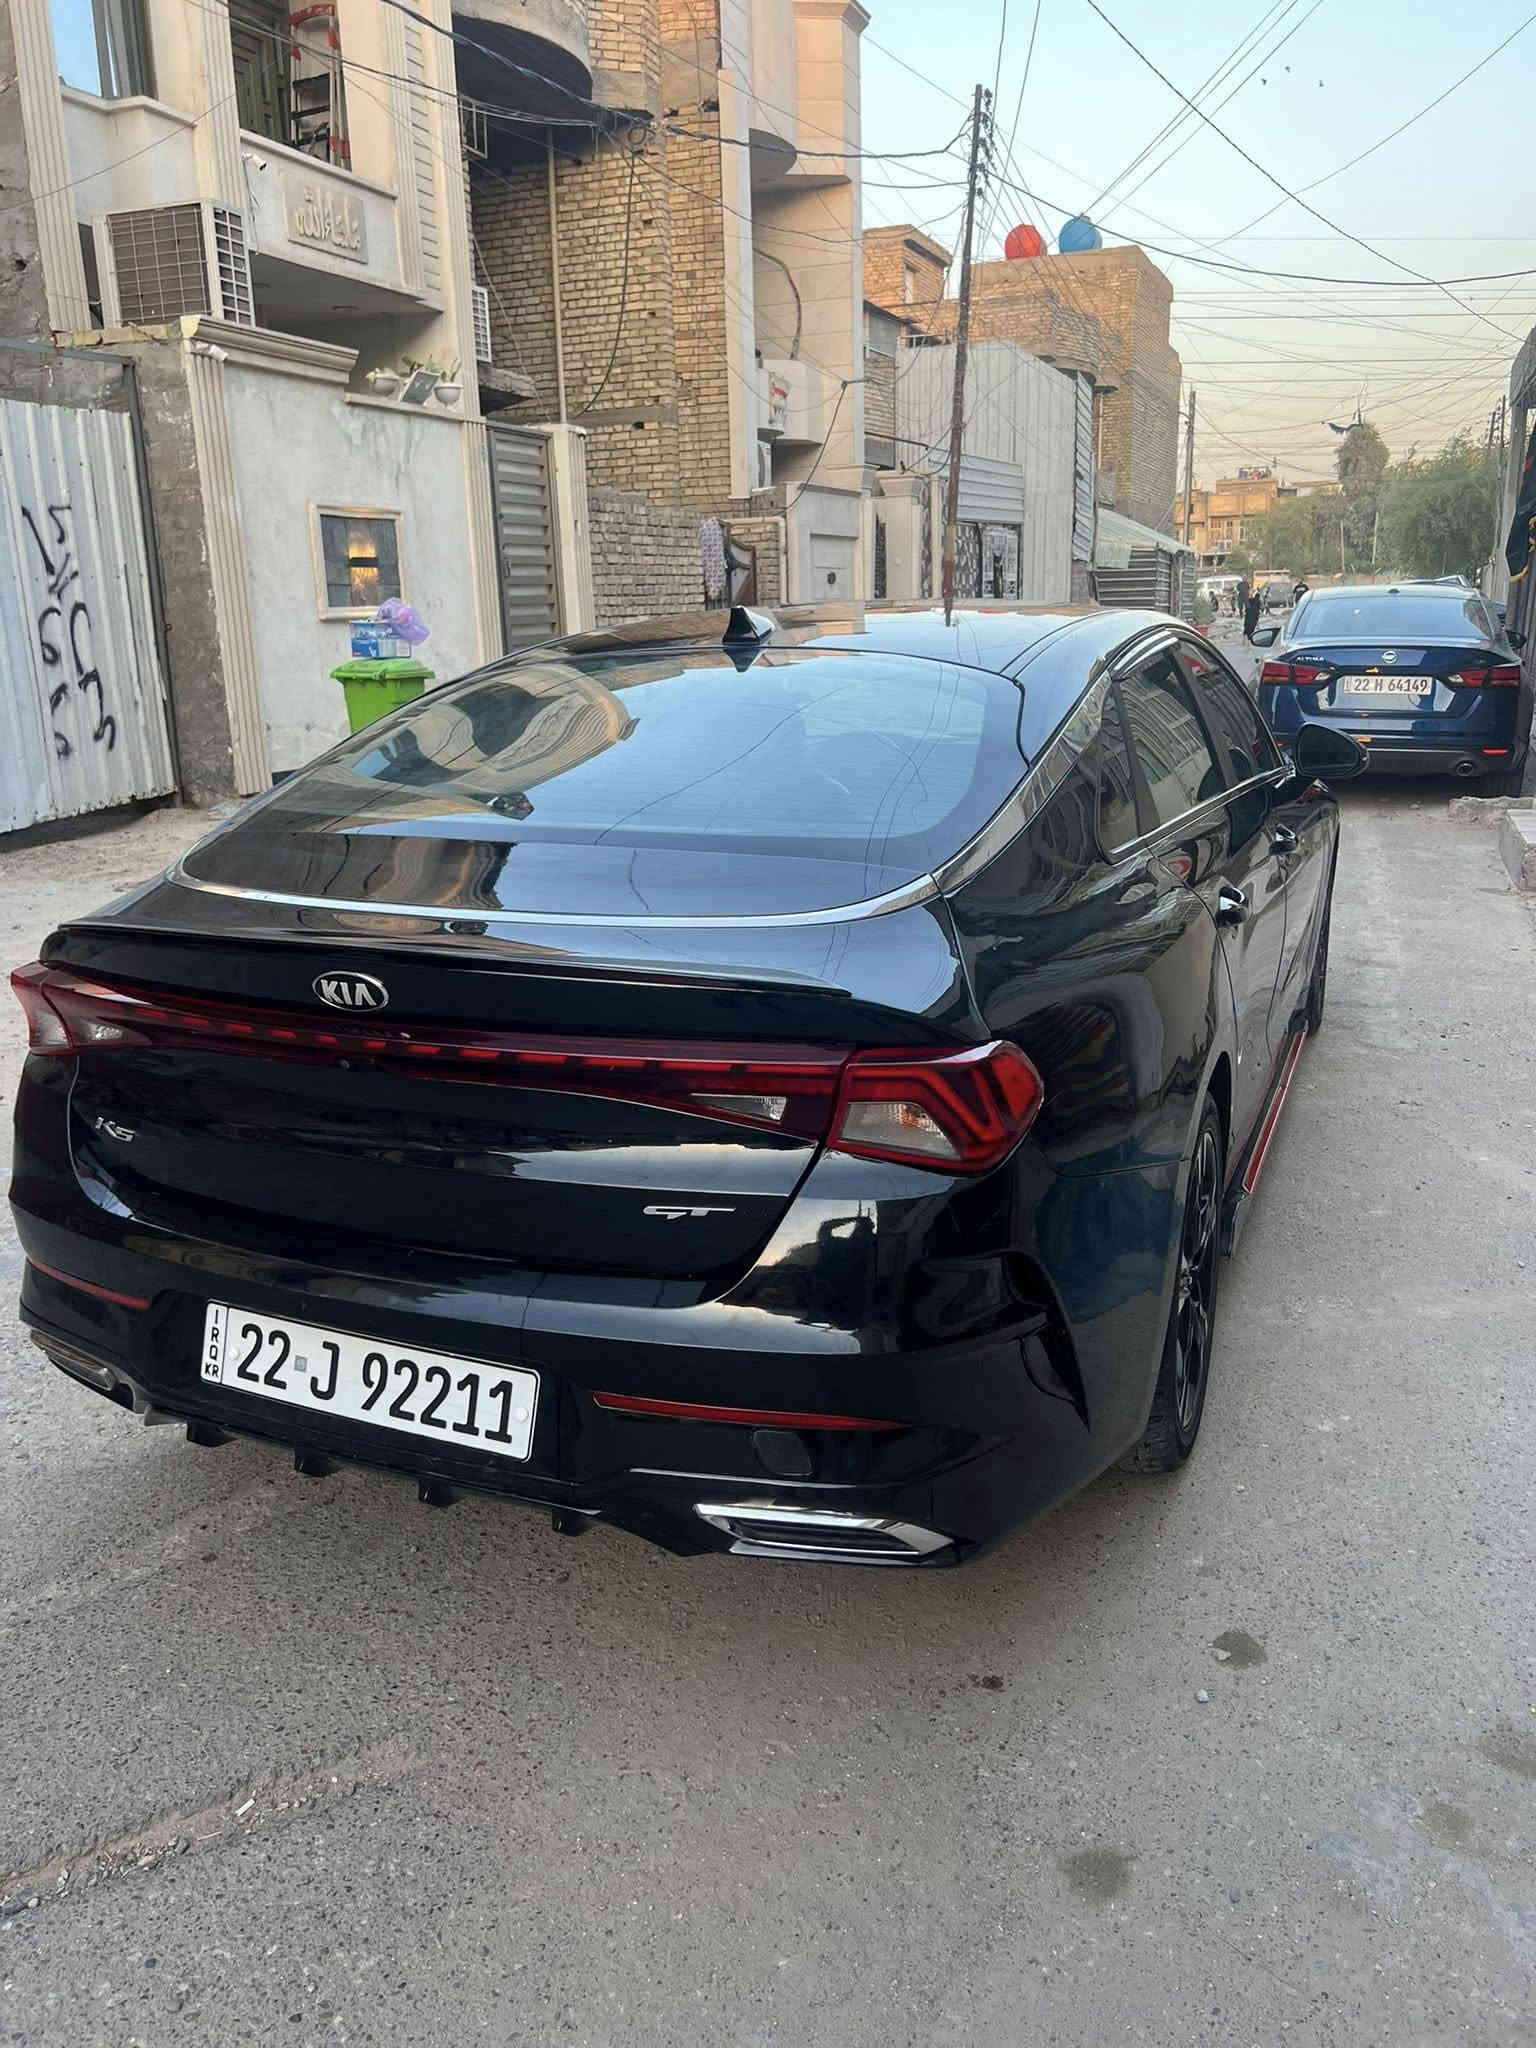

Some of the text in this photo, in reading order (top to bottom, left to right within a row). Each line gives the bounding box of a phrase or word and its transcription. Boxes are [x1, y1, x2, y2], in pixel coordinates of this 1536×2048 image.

[1354, 678, 1370, 692] 22
[1374, 678, 1383, 692] H
[1388, 678, 1428, 693] 64149
[321, 979, 377, 1006] KIA
[95, 1116, 136, 1142] K5
[643, 1206, 736, 1220] GT
[209, 1309, 220, 1361] IRQ
[204, 1362, 220, 1378] KR
[237, 1323, 513, 1444] 22 J 92211
